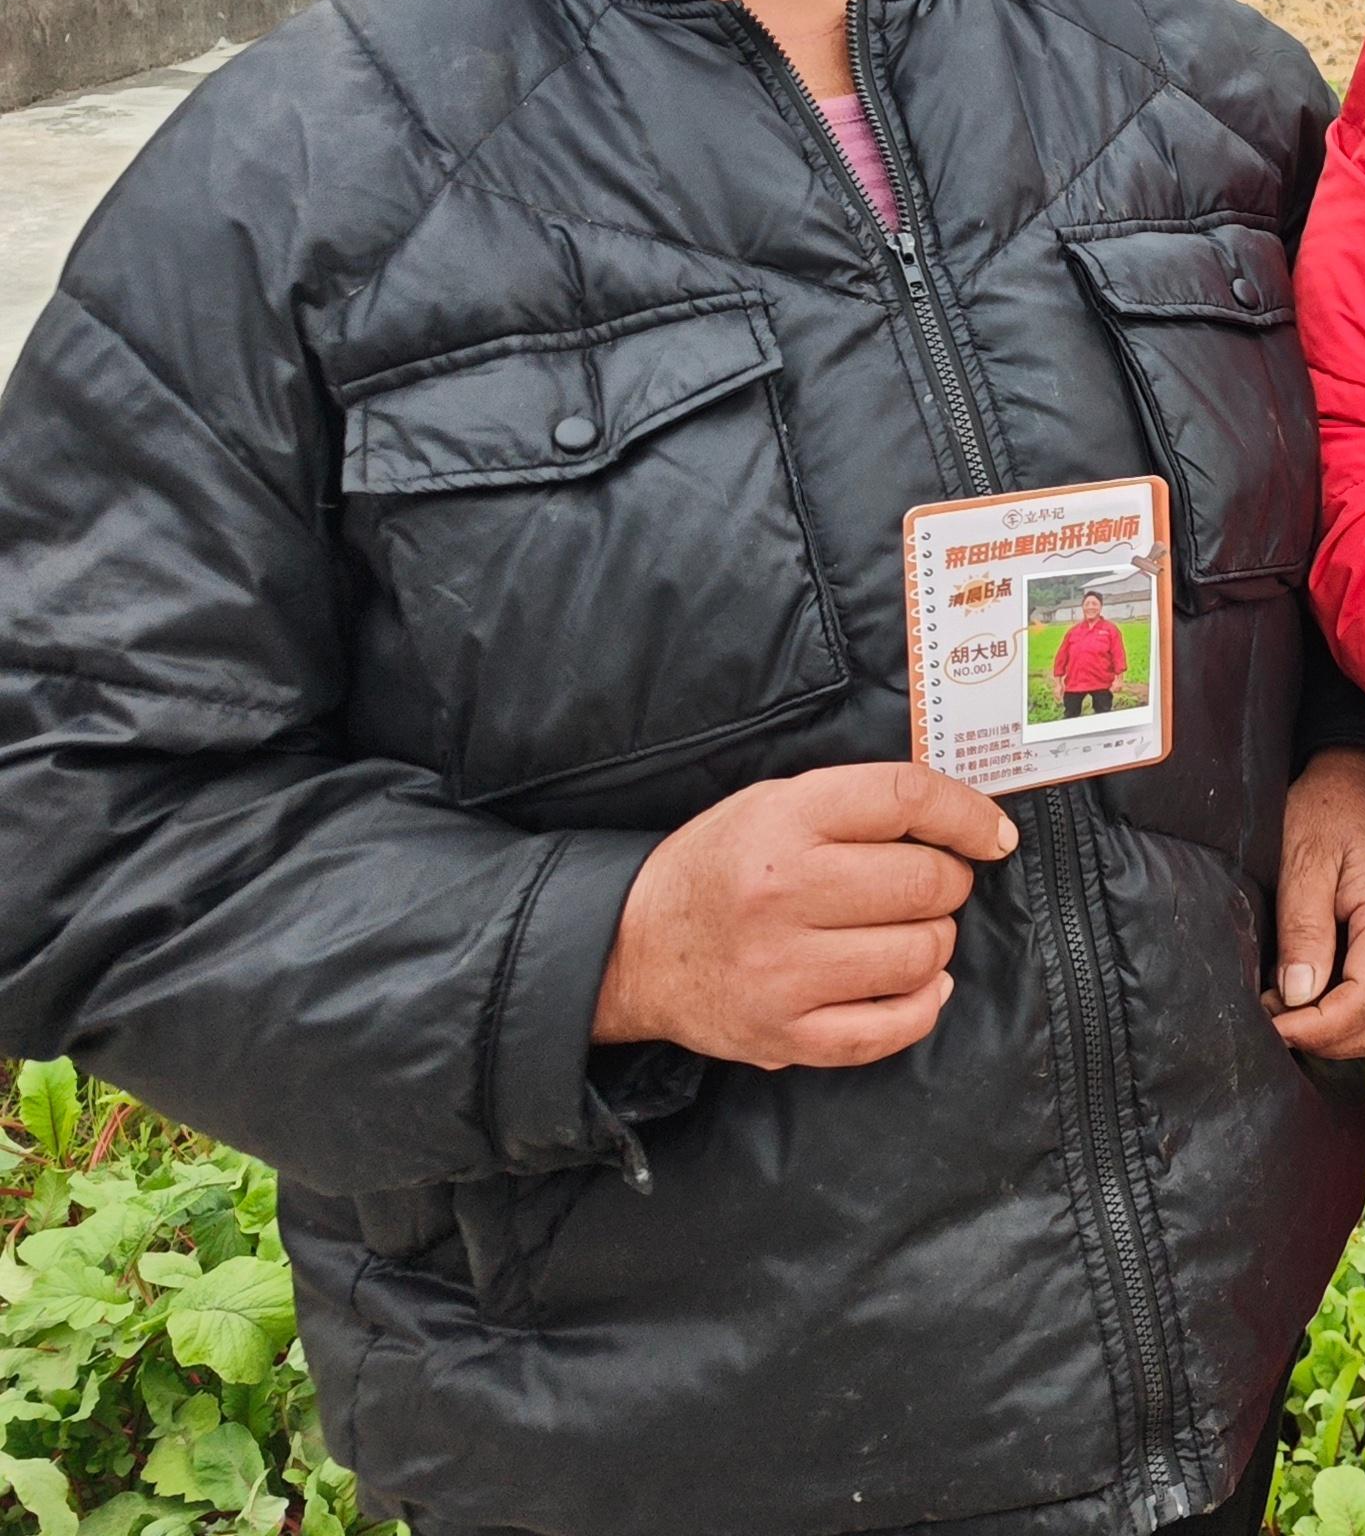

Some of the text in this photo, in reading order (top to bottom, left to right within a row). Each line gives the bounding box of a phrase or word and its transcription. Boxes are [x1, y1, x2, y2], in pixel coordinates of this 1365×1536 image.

[1023, 507, 1065, 524] 立早记
[945, 515, 1141, 570] 菜田地里的采摘师
[948, 577, 1013, 608] 清晨6点
[950, 640, 1009, 665] 胡大姐
[953, 663, 993, 677] NO.001
